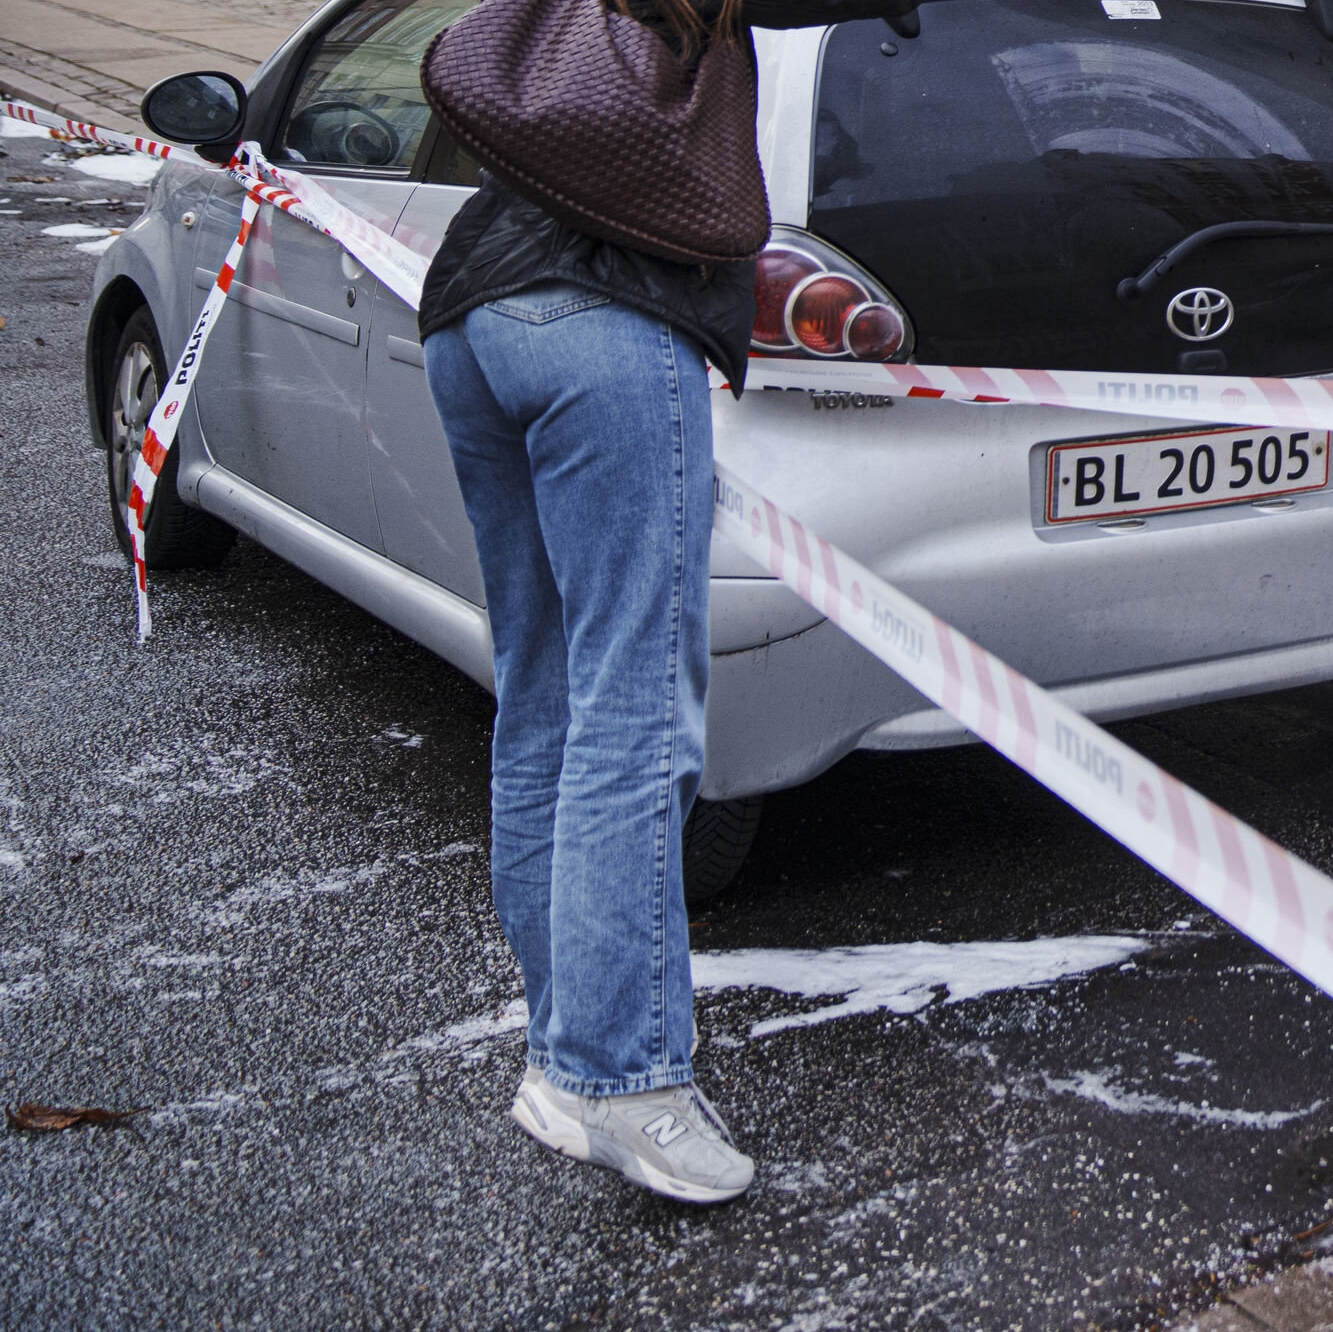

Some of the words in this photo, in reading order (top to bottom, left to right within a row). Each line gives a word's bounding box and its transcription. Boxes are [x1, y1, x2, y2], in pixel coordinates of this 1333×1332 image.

[810, 392, 894, 411] TOYOTA
[1074, 453, 1141, 507] BL
[1157, 443, 1216, 499] 20
[1228, 431, 1310, 489] 505
